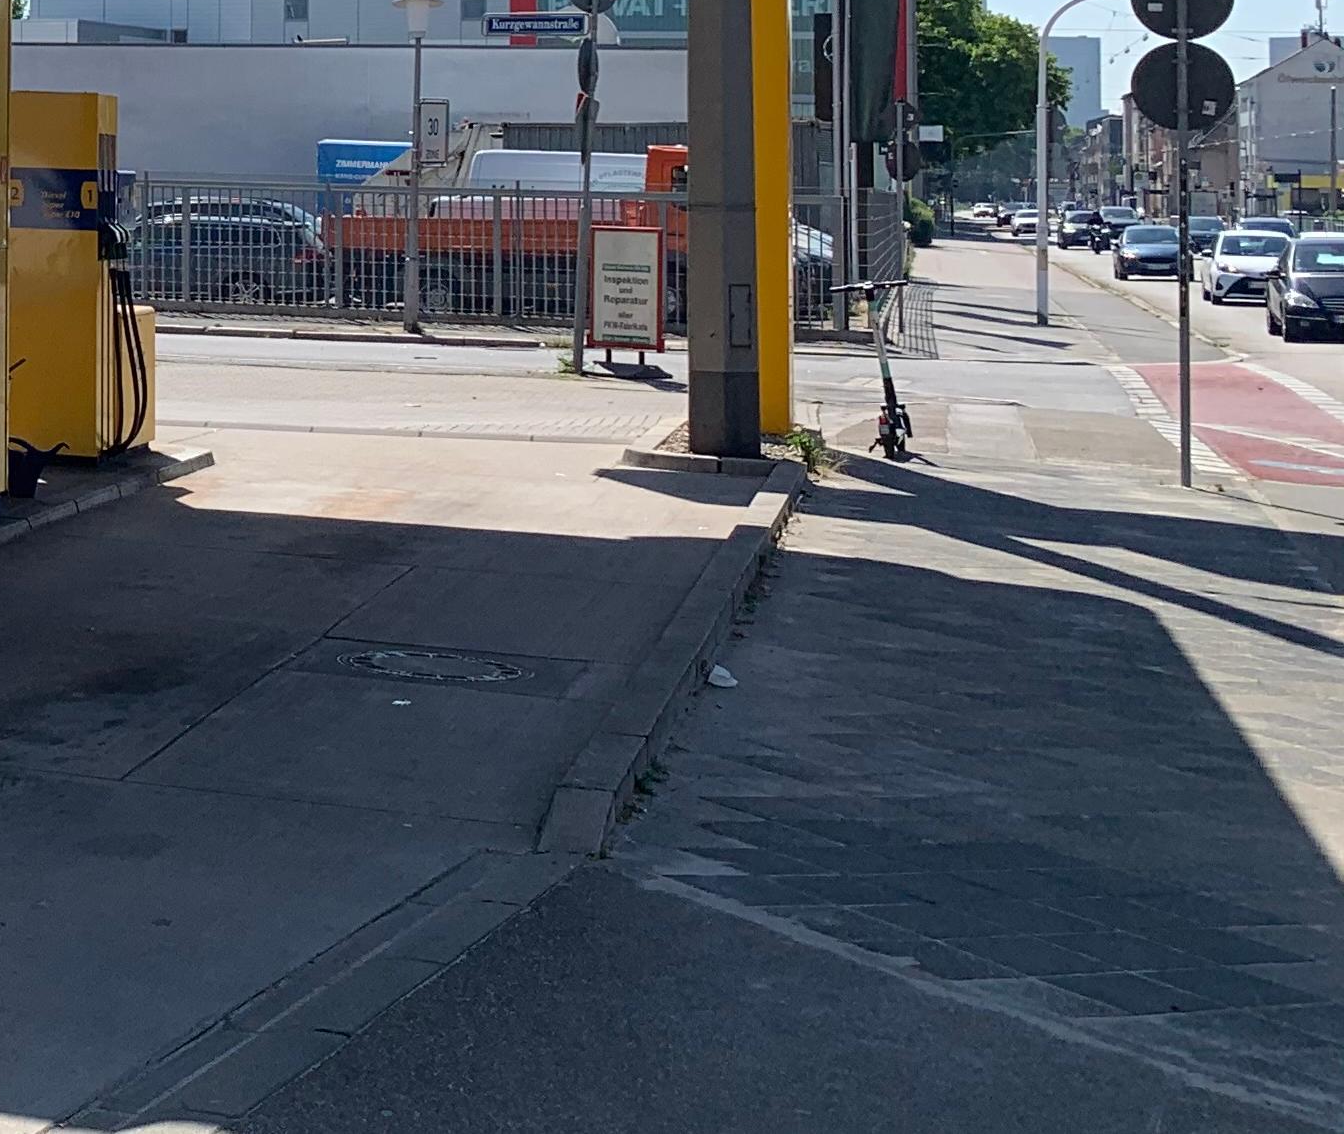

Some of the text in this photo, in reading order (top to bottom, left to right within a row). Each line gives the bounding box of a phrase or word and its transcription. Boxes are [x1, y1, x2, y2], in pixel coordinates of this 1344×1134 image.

[492, 18, 580, 32] Kurzgewannstraße
[427, 117, 439, 136] 30
[11, 186, 20, 200] 2
[86, 189, 92, 203] 1
[604, 275, 649, 286] Inspektion
[618, 286, 633, 294] und
[603, 295, 649, 306] Reparatur
